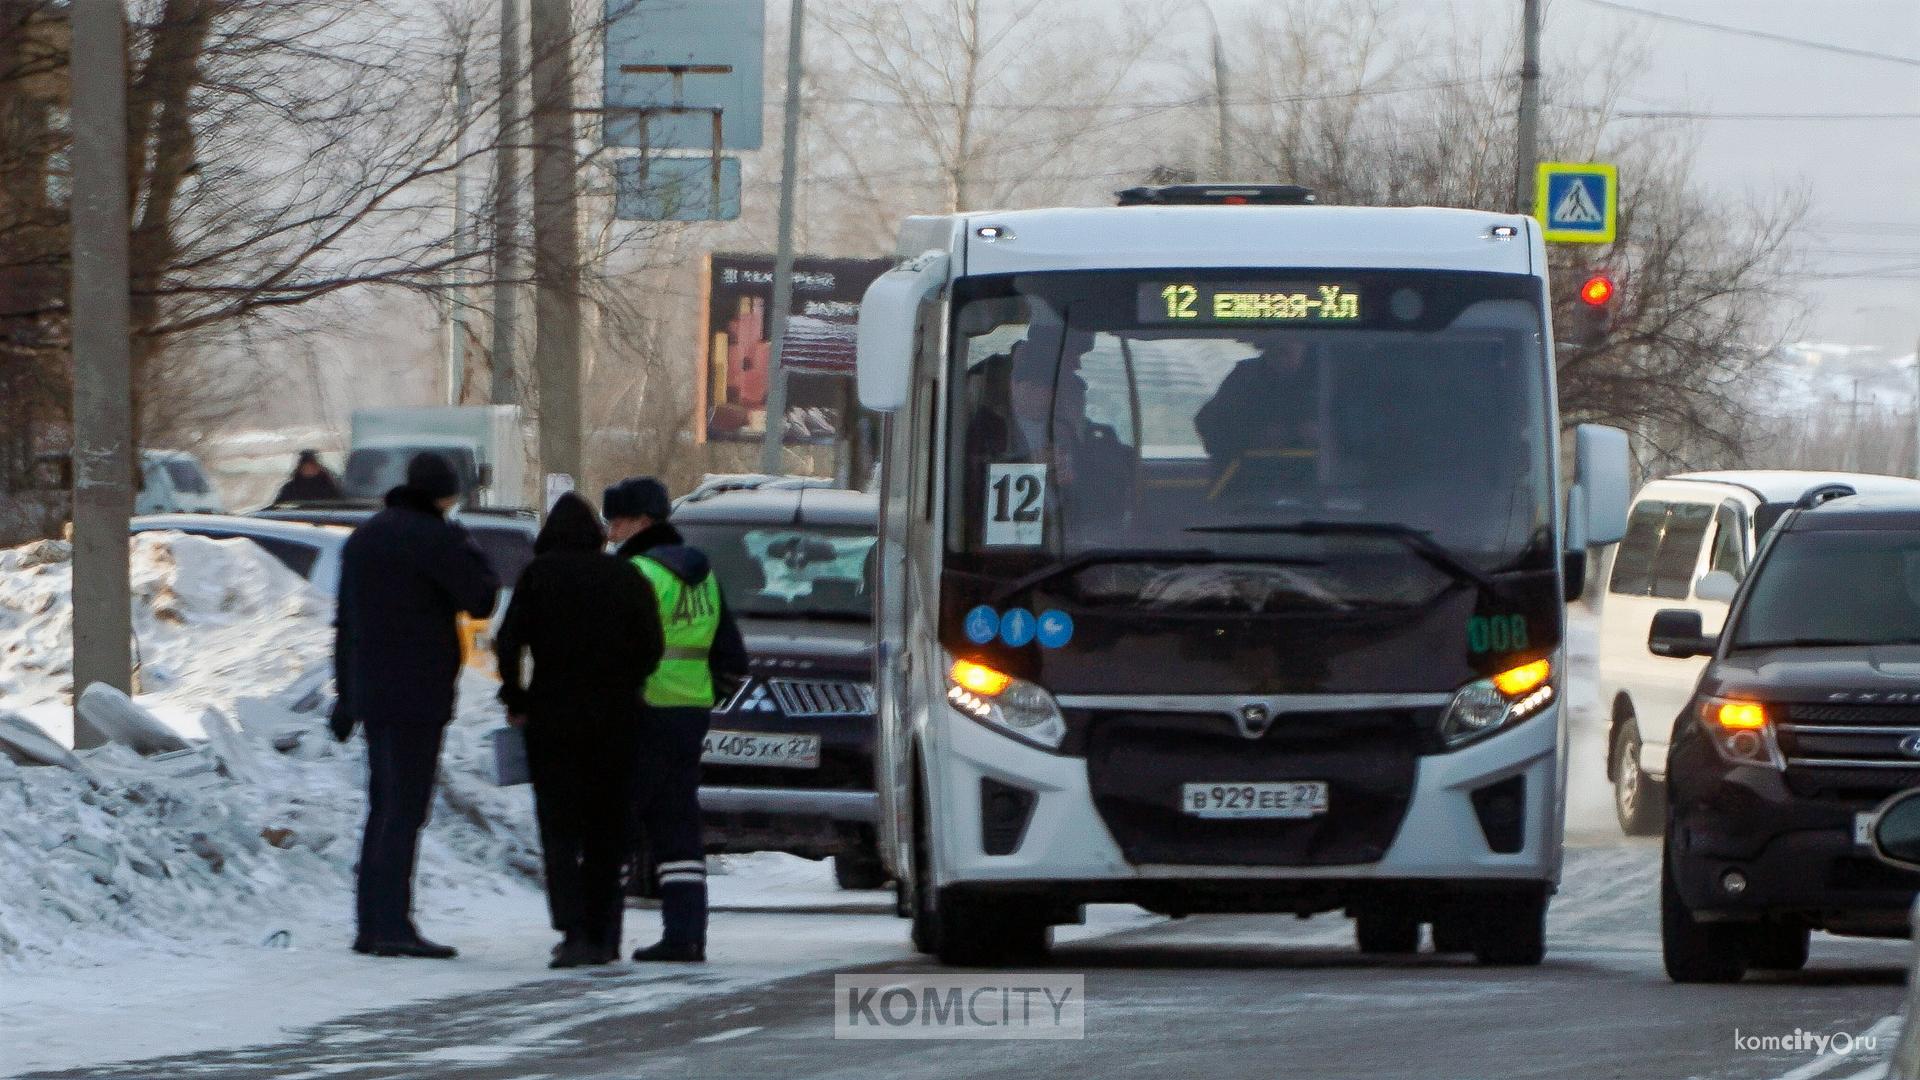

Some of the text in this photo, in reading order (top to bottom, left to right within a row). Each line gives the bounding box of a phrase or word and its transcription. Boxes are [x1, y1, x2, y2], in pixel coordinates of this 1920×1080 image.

[1161, 284, 1198, 318] 12
[993, 474, 1041, 522] 12
[1466, 613, 1528, 653] 008
